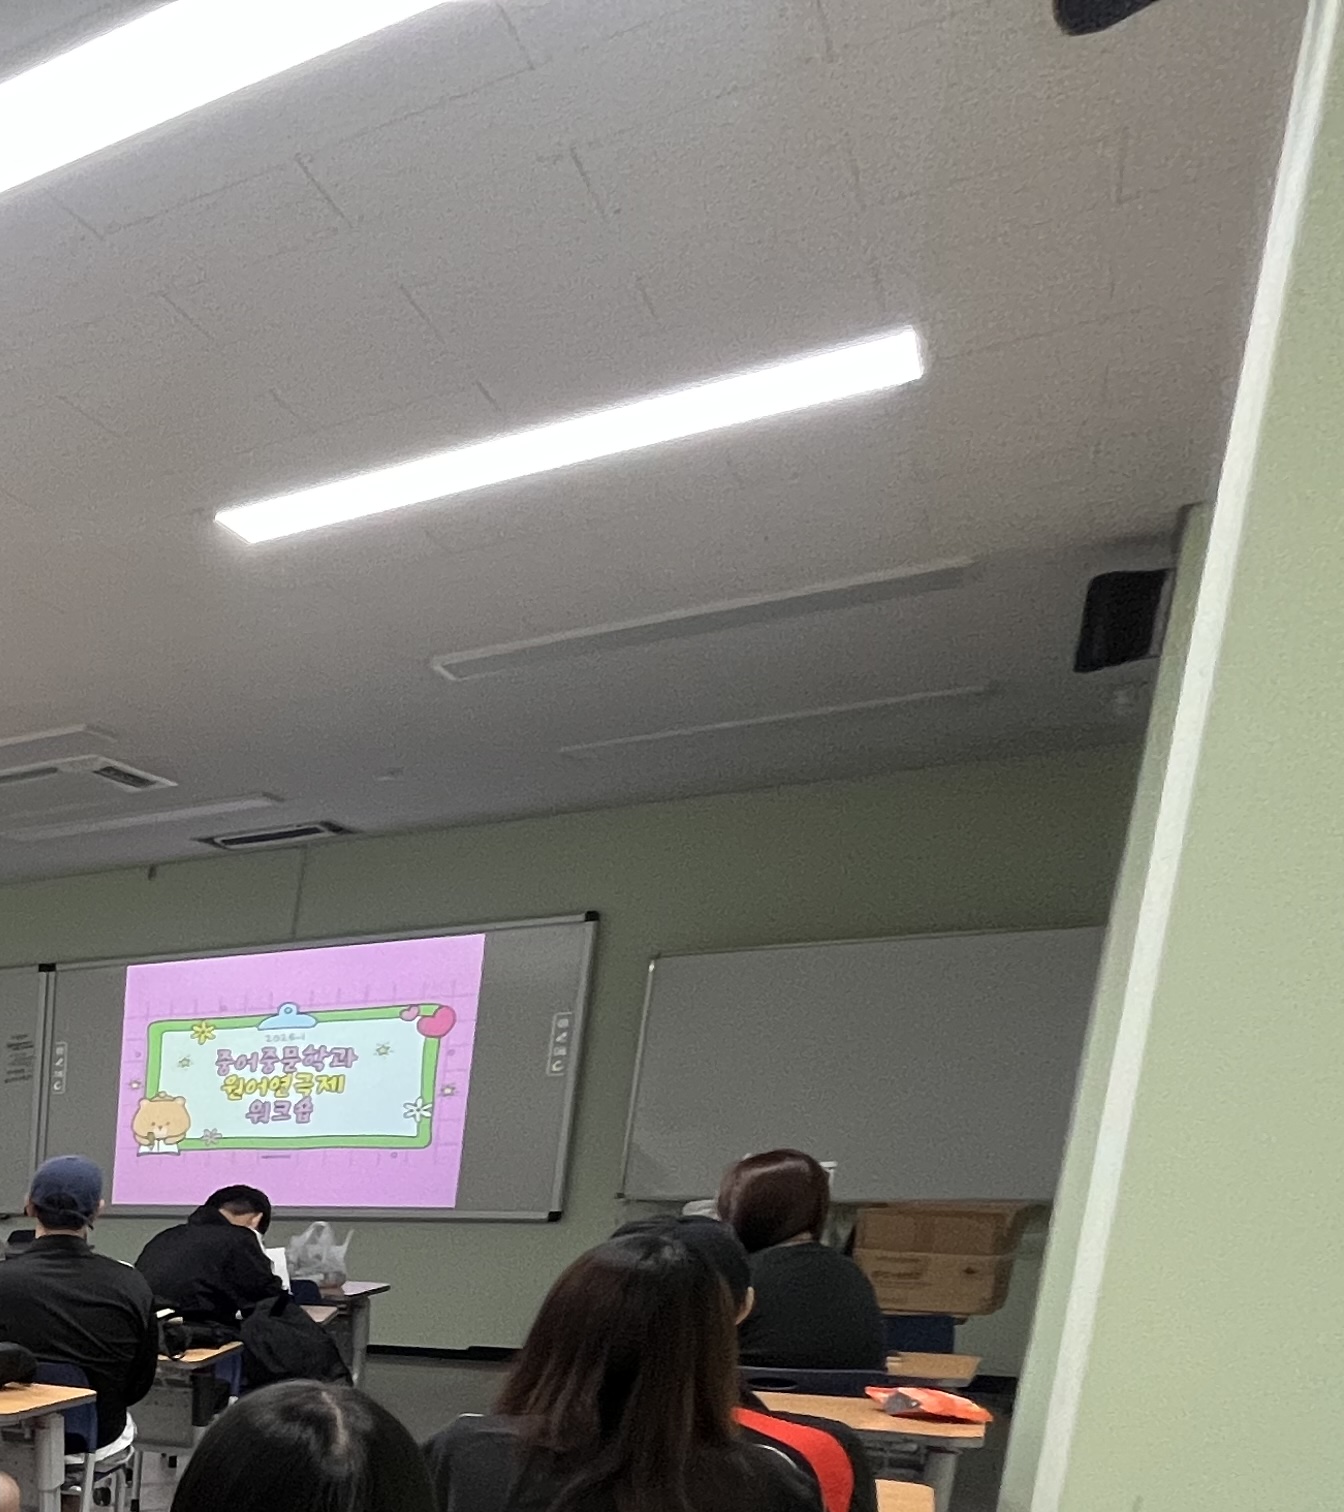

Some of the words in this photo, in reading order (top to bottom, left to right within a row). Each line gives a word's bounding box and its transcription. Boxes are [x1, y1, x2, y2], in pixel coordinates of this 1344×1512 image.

[216, 1044, 359, 1077] 중어중문학과
[220, 1072, 346, 1101] 원어연극제
[245, 1096, 314, 1125] 워크숍
